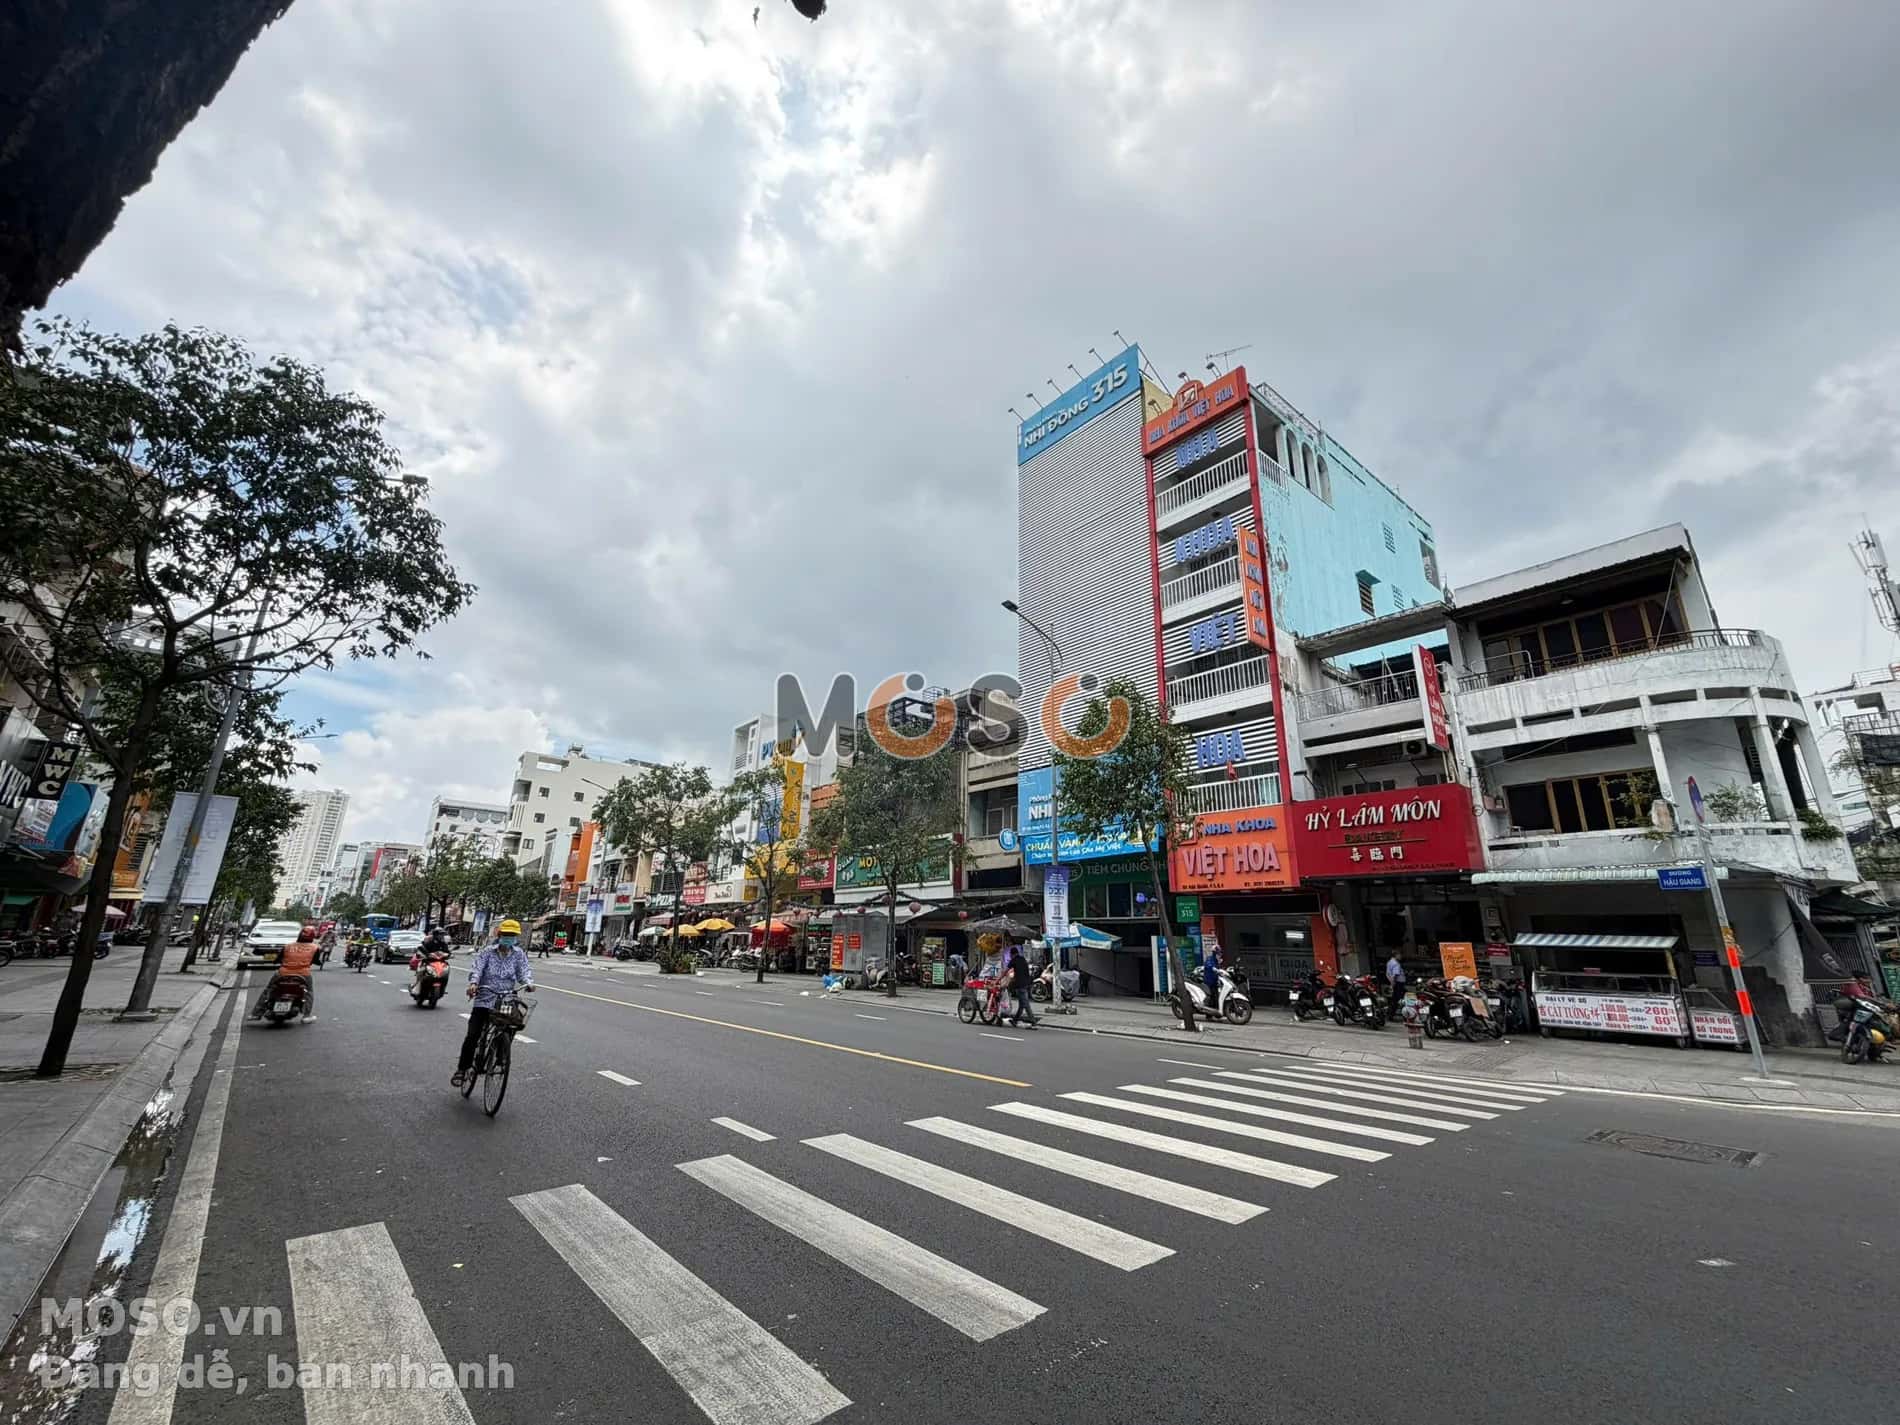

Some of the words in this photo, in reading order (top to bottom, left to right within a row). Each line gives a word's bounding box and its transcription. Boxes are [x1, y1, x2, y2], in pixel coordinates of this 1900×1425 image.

[1024, 425, 1046, 448] NHI
[1091, 363, 1128, 402] 315
[1175, 515, 1236, 563] KHOA
[1188, 612, 1238, 653] VIỆT
[1195, 729, 1246, 768] HOA
[38, 746, 76, 796] MWC
[1028, 803, 1052, 820] NHI
[1204, 822, 1233, 837] NHA
[1236, 817, 1278, 834] KHOA
[1305, 805, 1330, 831] HỶ
[1337, 802, 1384, 828] LÂM
[1390, 795, 1441, 822] MÔN
[1182, 844, 1228, 880] VIỆT
[1234, 842, 1281, 873] HOA
[1679, 877, 1702, 886] GIANG
